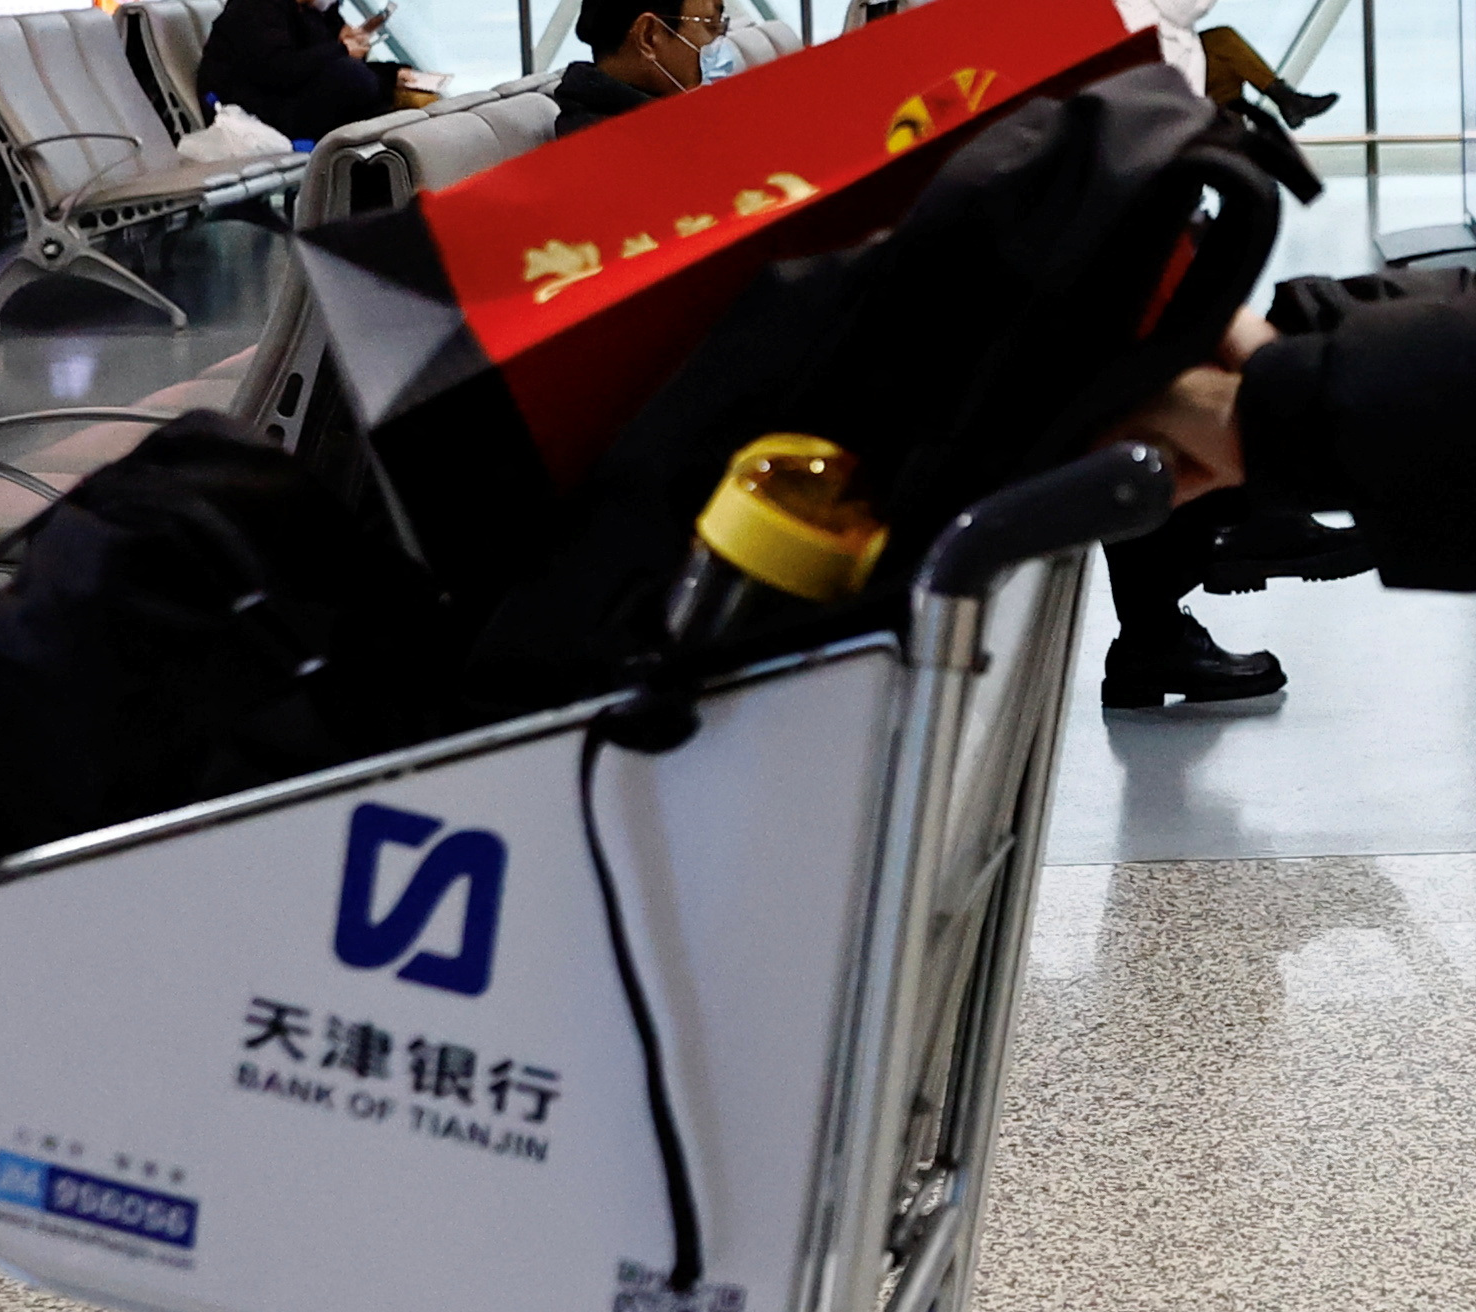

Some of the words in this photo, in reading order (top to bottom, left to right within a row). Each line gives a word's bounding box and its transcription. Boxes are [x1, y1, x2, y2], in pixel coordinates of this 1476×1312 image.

[236, 1061, 335, 1111] BANK
[348, 1090, 392, 1123] OF
[411, 1104, 550, 1164] TIANJIN
[244, 996, 562, 1124] 天津银行
